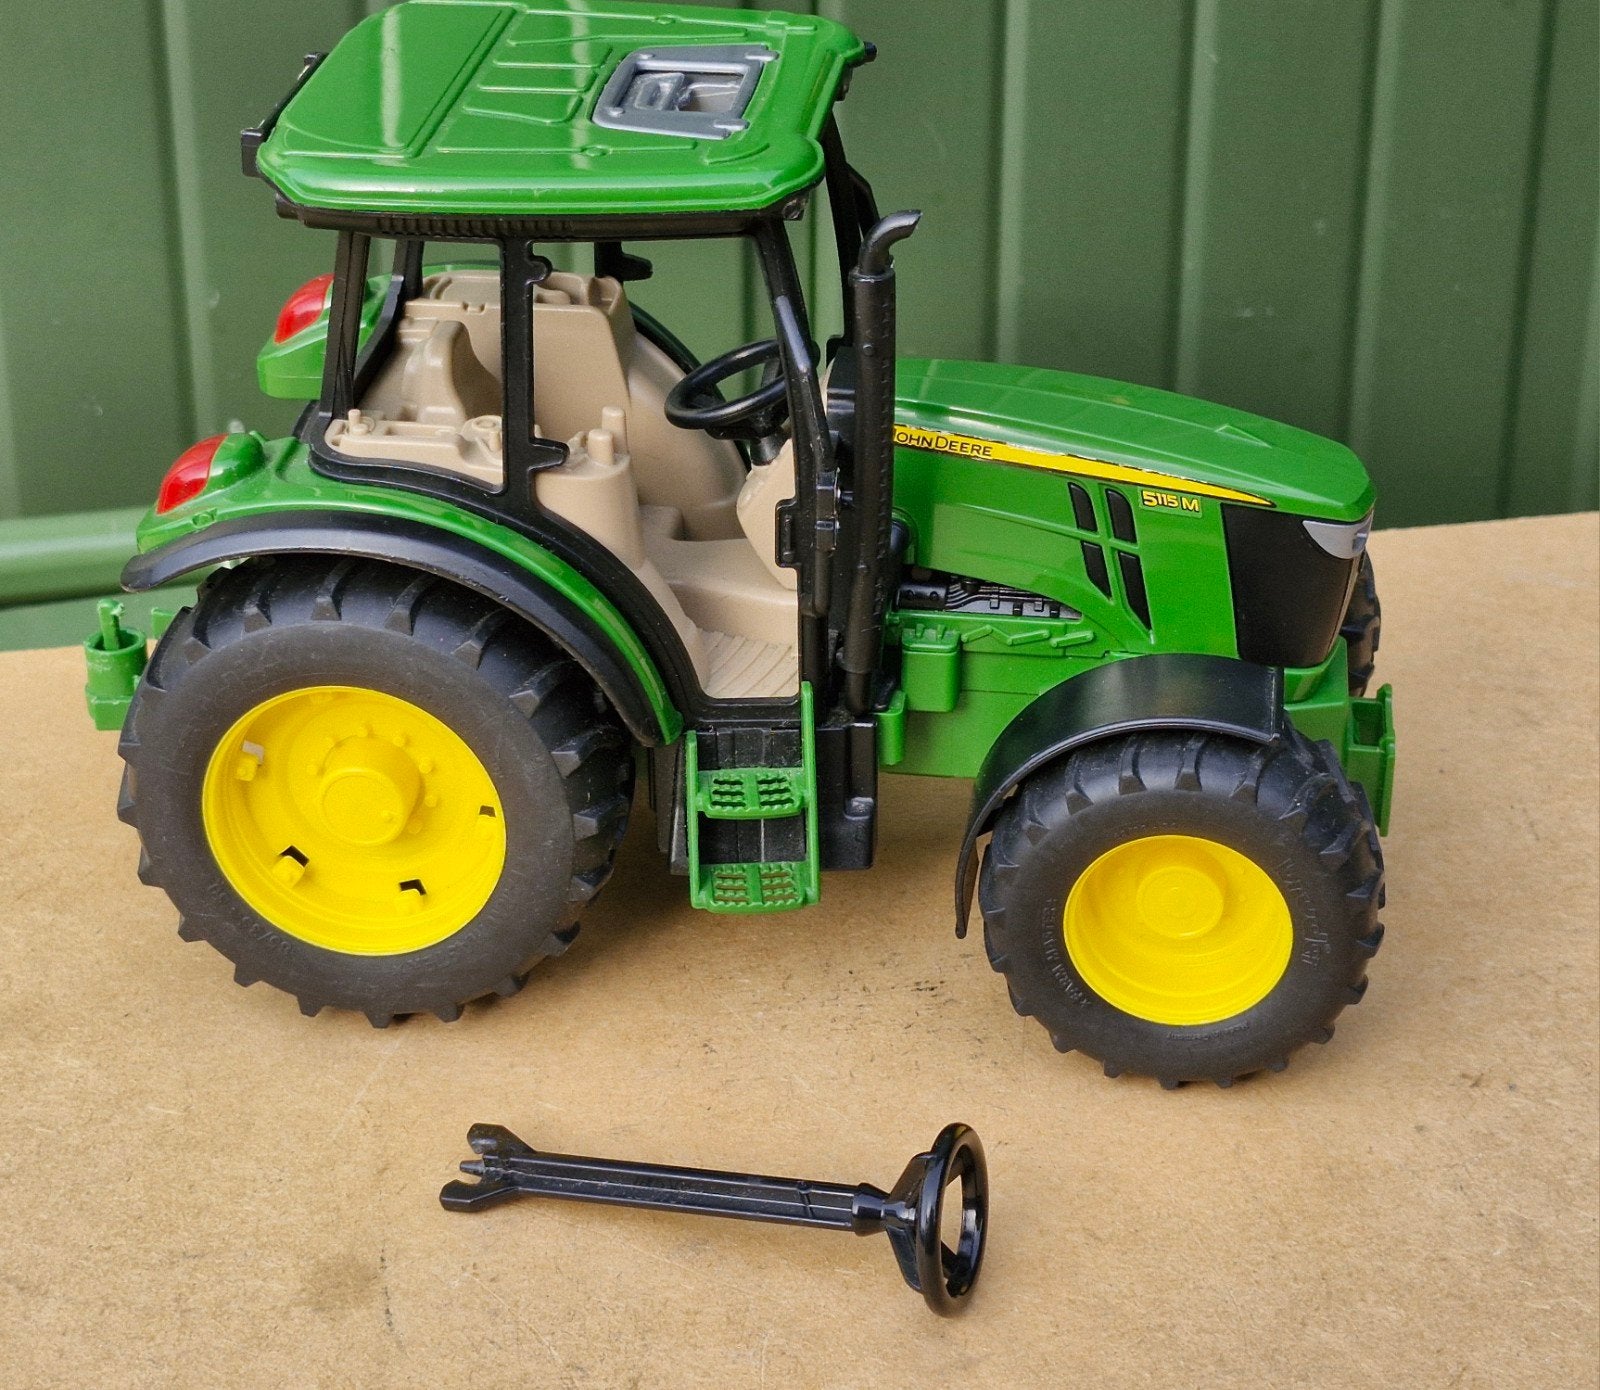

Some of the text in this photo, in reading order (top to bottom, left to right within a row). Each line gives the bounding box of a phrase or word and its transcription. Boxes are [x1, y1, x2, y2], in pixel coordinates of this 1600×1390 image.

[935, 435, 993, 457] DEERE
[1142, 490, 1200, 512] 5115 M
